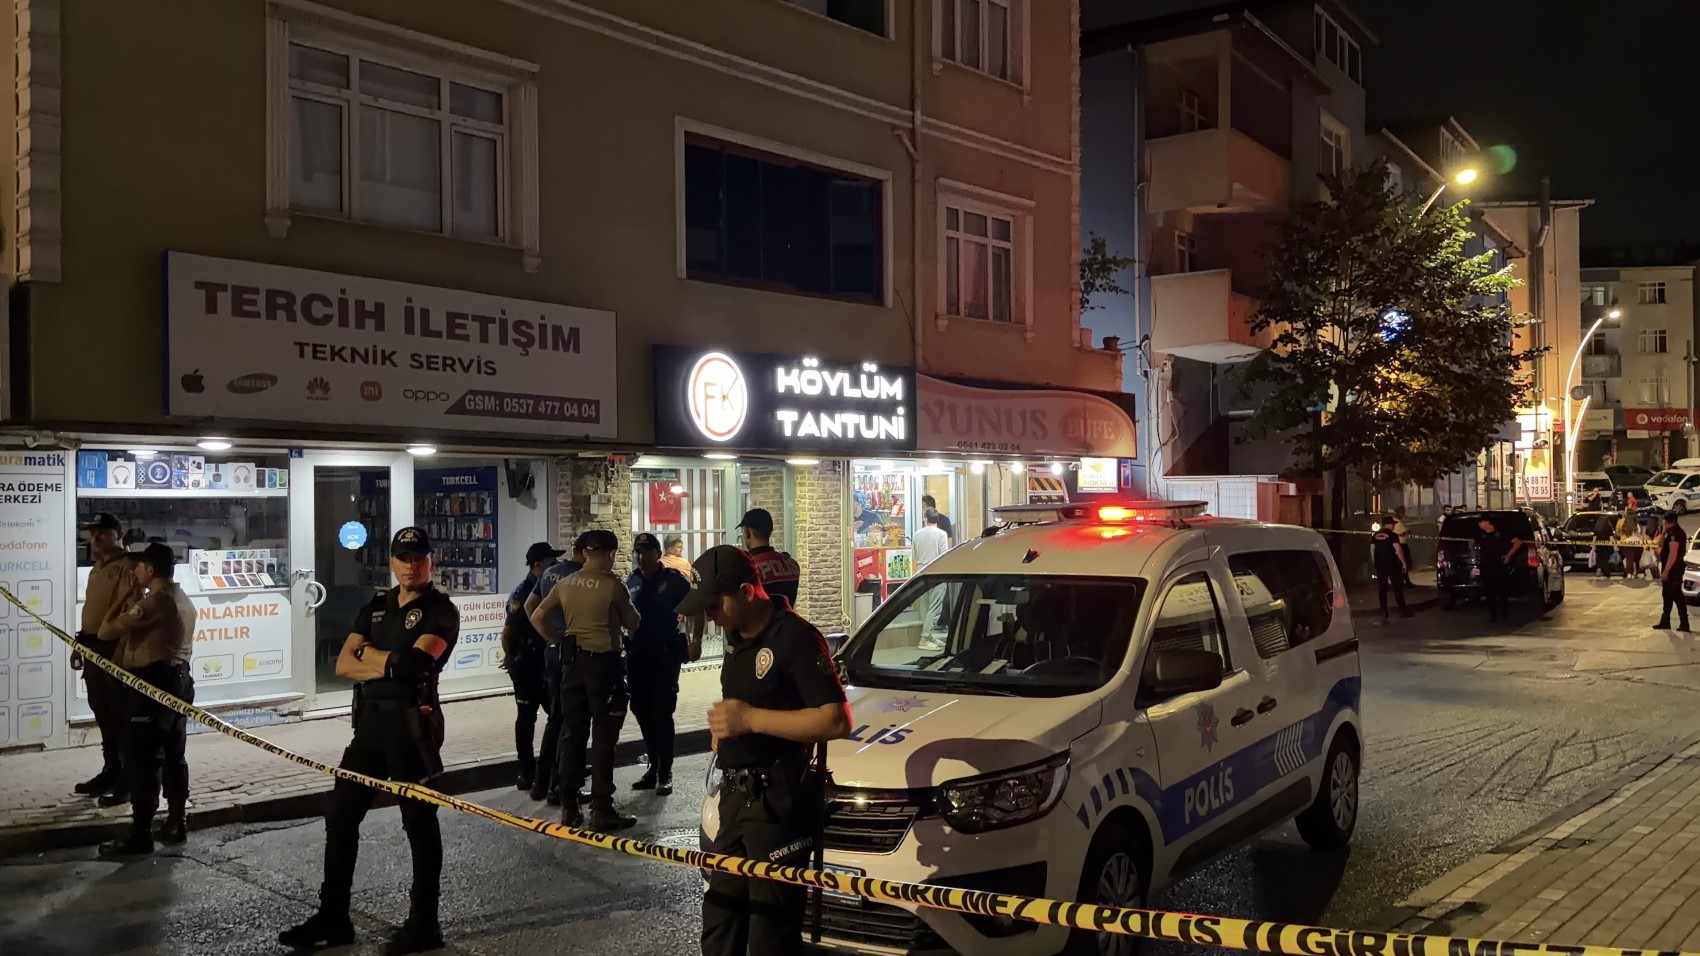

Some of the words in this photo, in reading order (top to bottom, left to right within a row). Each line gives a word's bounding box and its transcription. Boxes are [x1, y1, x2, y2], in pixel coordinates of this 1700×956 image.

[194, 280, 386, 333] TERCİH
[403, 296, 581, 357] İLETİŞİM
[293, 340, 399, 369] TEKNİK
[409, 352, 498, 377] SERVİS
[402, 388, 450, 403] oppo
[776, 357, 904, 401] KÖYLÜM
[464, 393, 501, 413] GSM:
[503, 396, 534, 414] 0537
[537, 399, 561, 416] 477
[563, 400, 579, 417] 04
[581, 402, 597, 418] 04
[918, 398, 1049, 442] YUNUS
[776, 407, 905, 441] TANTUNİ
[18, 480, 62, 492] ÖDEME
[1540, 486, 1549, 495] 95
[192, 626, 251, 643] ATILIR
[465, 633, 485, 644] 537
[1183, 761, 1235, 825] POLİS
[1093, 905, 1223, 946] POLİS
